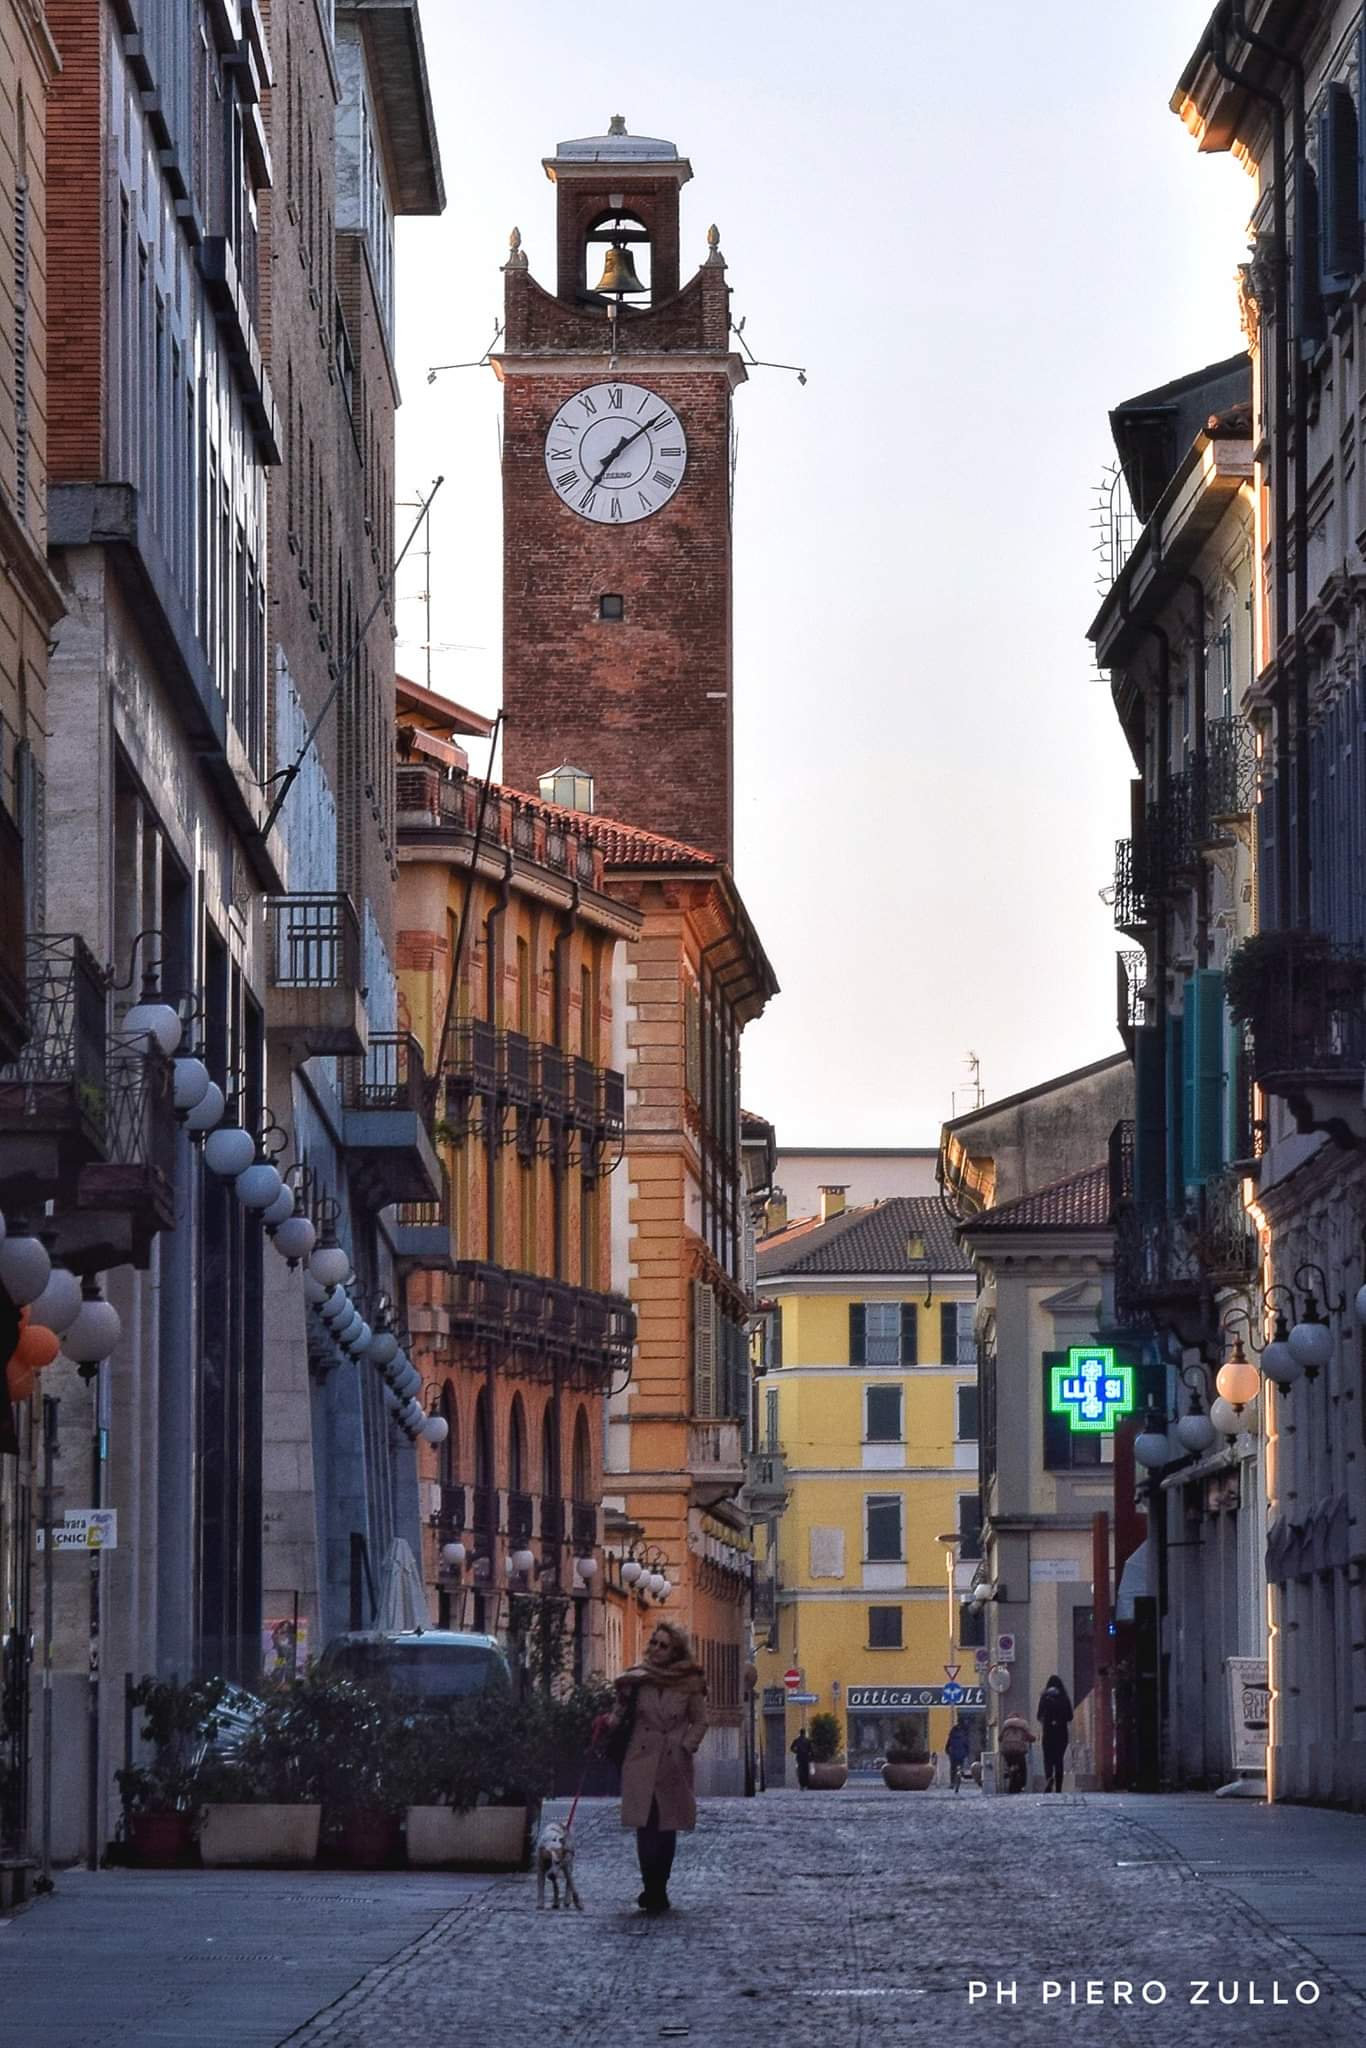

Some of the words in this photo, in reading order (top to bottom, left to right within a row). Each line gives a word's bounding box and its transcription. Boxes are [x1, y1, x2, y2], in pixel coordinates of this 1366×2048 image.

[578, 395, 597, 418] XI
[608, 388, 623, 409] XII
[636, 395, 649, 415] I
[557, 418, 580, 435] X
[551, 448, 572, 461] IX
[660, 447, 682, 457] III
[556, 470, 581, 494] VIII
[578, 489, 597, 513] VII
[610, 497, 623, 518] VI
[638, 491, 653, 511] V
